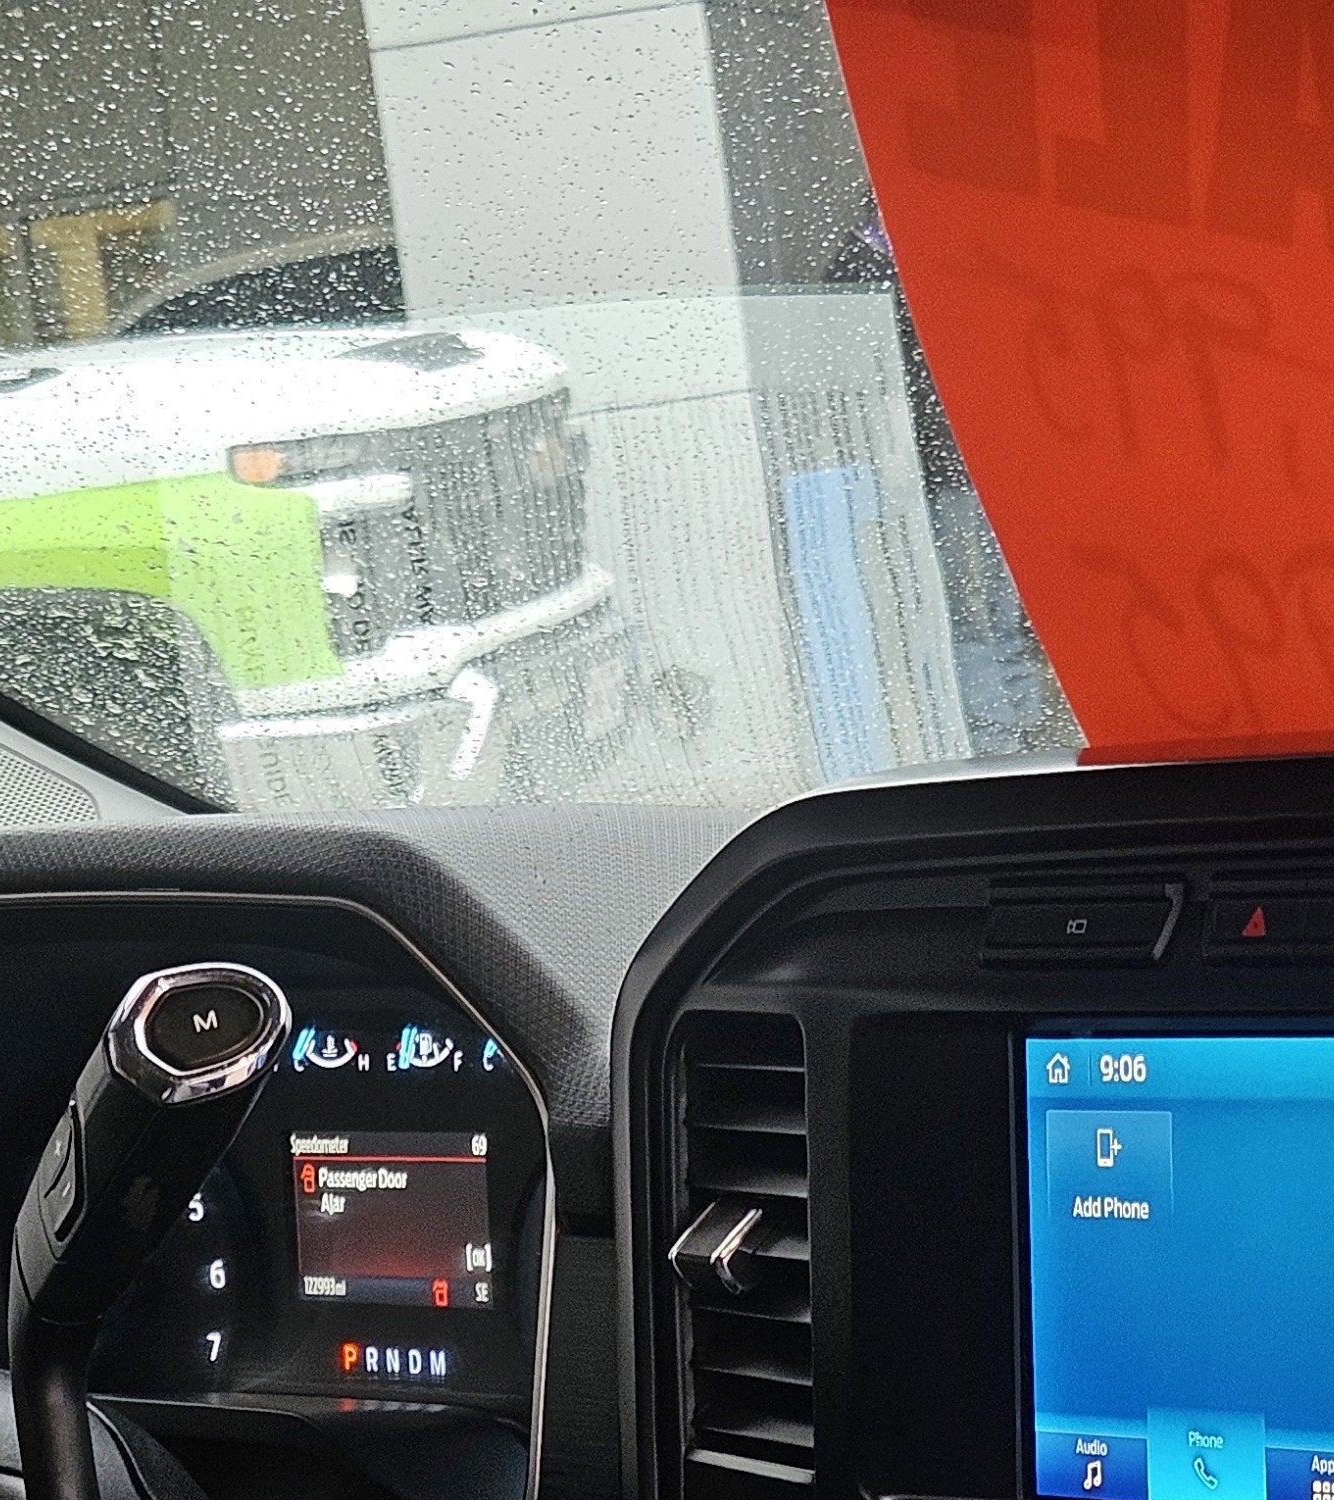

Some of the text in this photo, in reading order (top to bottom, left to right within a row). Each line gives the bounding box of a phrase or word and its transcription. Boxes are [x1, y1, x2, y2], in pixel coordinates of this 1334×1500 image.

[193, 1009, 218, 1033] M
[358, 1053, 369, 1071] H
[387, 1050, 464, 1072] E F
[1099, 1054, 1147, 1084] 9:06
[290, 1134, 348, 1155] Speedometer
[318, 1167, 407, 1191] Passenger Door
[188, 1194, 205, 1221] 5
[321, 1194, 345, 1215] Ajar
[1072, 1196, 1150, 1221] Add Phone
[209, 1260, 227, 1290] 6
[475, 1283, 489, 1303] SE
[206, 1332, 222, 1361] 7
[343, 1343, 446, 1375] P R N D M
[1074, 1437, 1108, 1459] Audio
[1188, 1430, 1224, 1449] Phone
